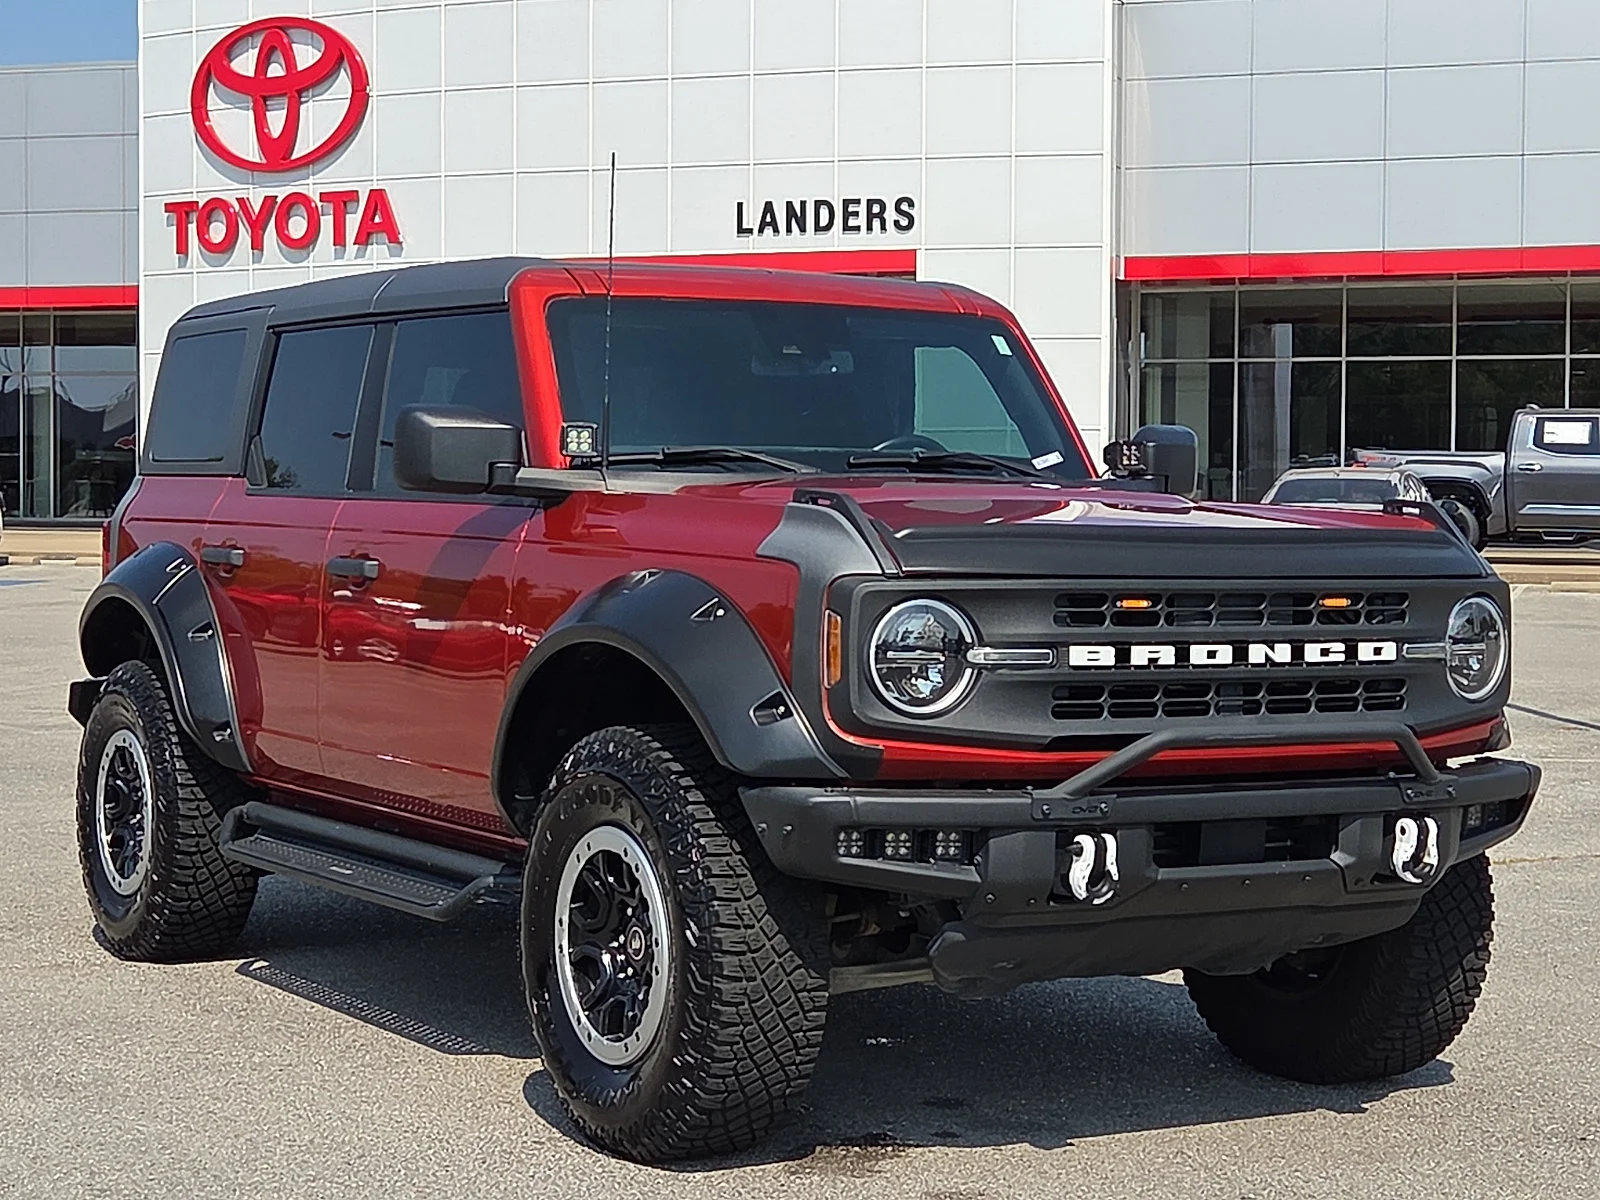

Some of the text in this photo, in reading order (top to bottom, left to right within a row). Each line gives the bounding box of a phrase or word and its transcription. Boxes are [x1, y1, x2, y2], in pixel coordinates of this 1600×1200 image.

[164, 188, 403, 256] TOYOTA
[736, 196, 916, 236] LANDERS
[1068, 641, 1397, 667] BRONCO
